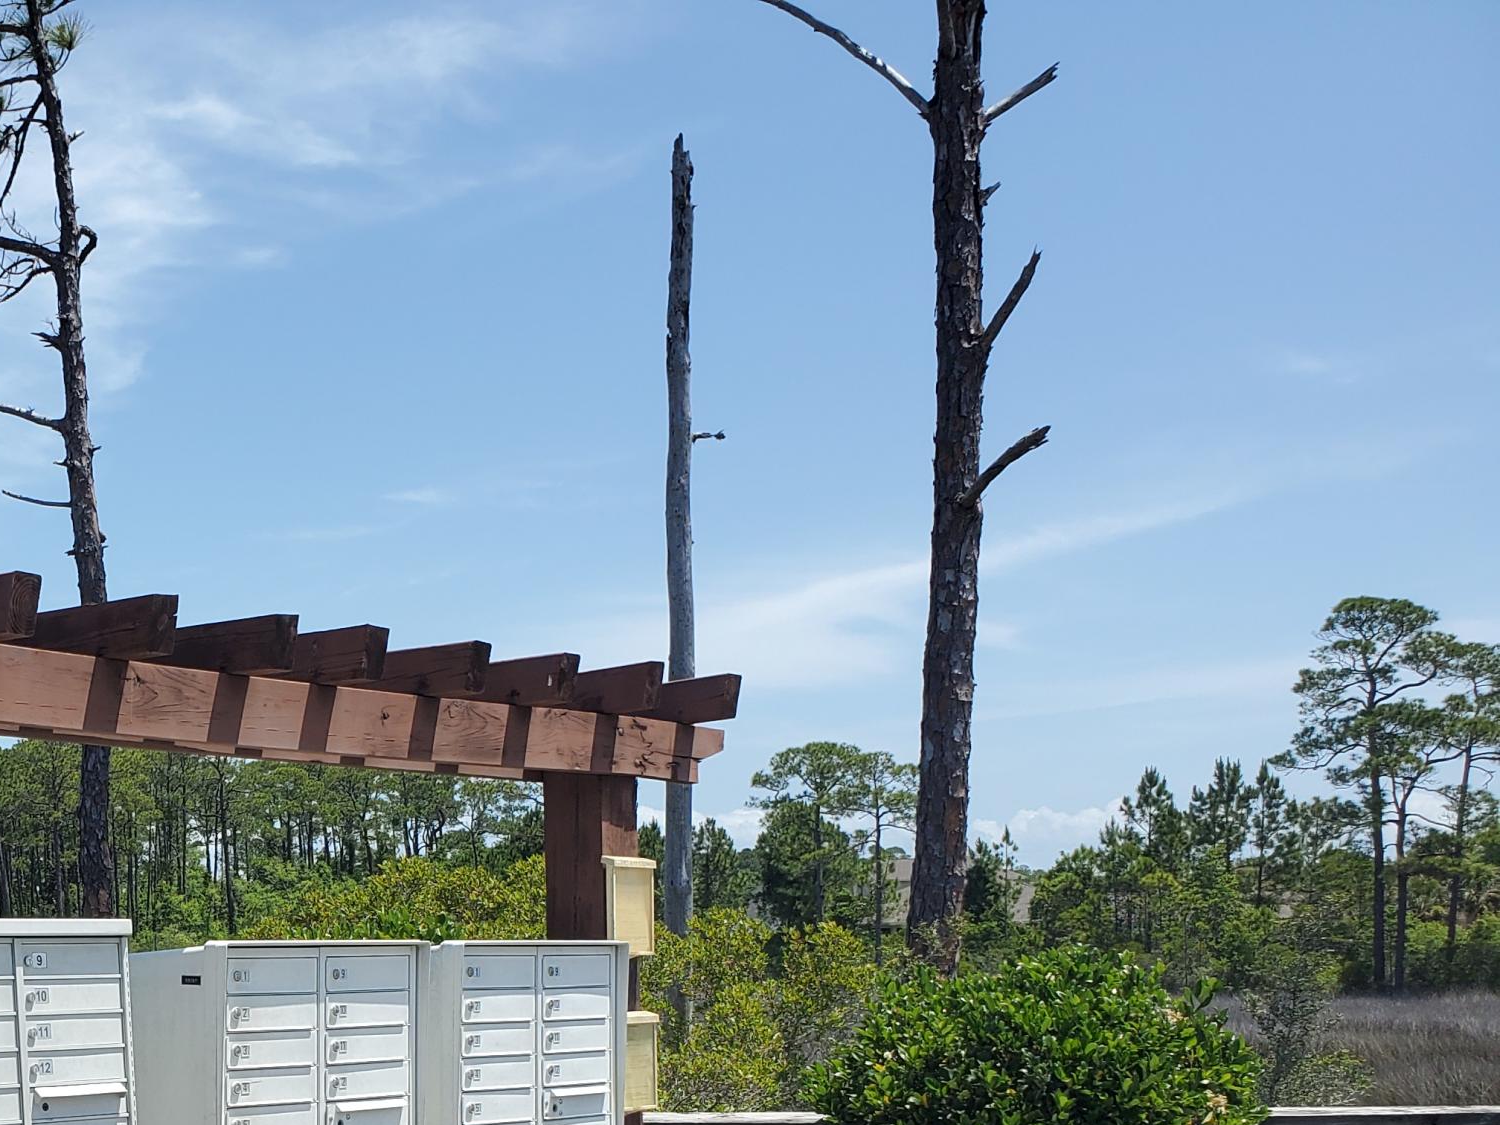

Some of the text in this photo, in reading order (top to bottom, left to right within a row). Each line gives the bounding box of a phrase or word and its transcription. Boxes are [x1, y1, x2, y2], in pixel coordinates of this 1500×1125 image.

[36, 954, 43, 966] 9
[341, 968, 346, 979] 9
[36, 990, 47, 1002] 10
[242, 1008, 248, 1018] 2
[38, 1026, 49, 1037] 11
[242, 1045, 248, 1056] 3
[40, 1062, 51, 1073] 12
